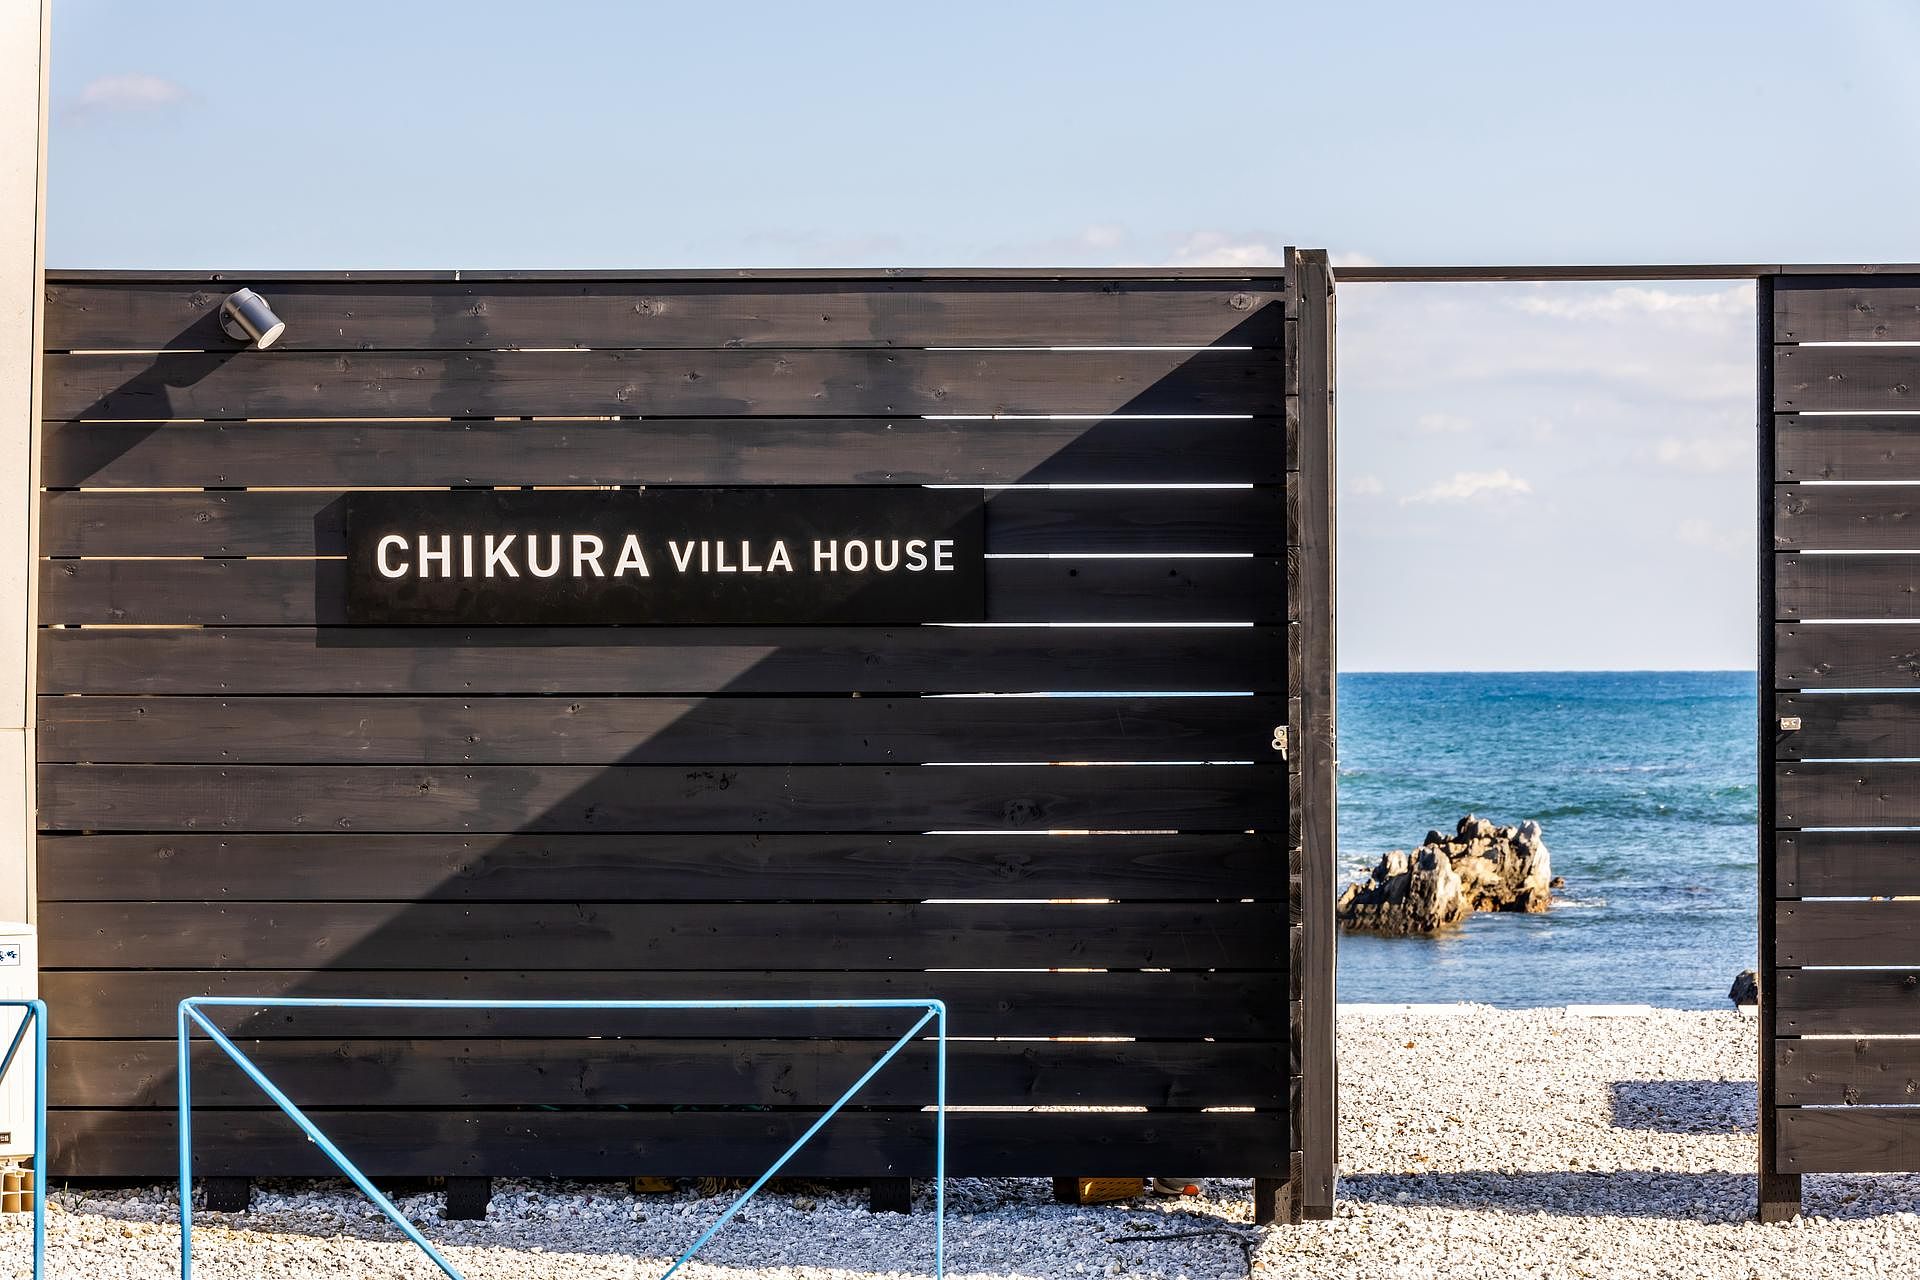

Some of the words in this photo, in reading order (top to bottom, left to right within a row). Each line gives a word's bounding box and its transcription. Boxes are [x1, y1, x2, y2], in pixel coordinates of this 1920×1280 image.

[377, 534, 650, 578] CHIKURA
[668, 540, 794, 572] VILLA
[813, 539, 954, 572] HOUSE
